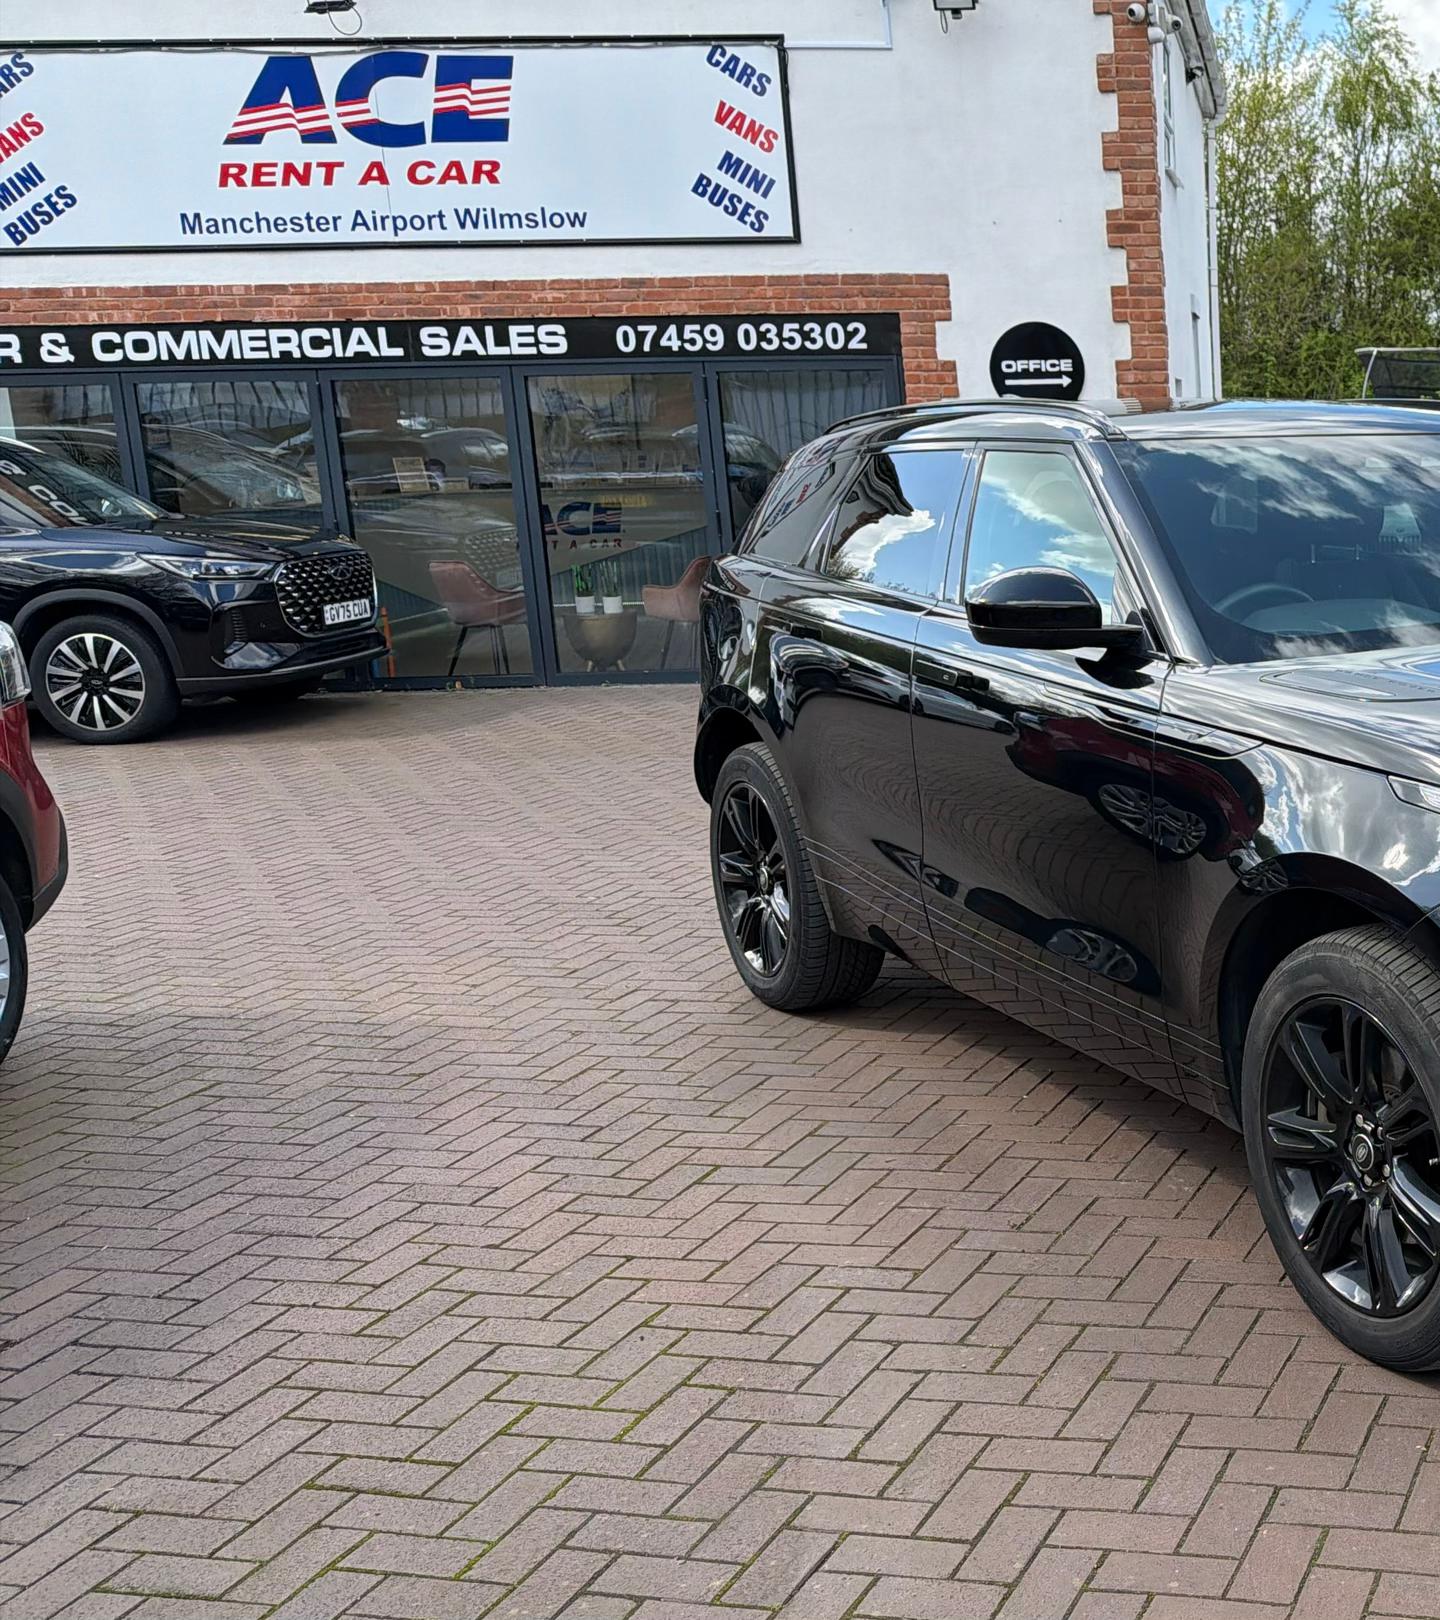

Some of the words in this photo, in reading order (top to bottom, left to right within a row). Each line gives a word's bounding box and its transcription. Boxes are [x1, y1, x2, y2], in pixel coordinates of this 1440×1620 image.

[706, 44, 772, 97] CARS
[222, 50, 513, 148] ACE
[714, 99, 779, 154] VANS
[218, 161, 344, 187] RENT
[358, 161, 390, 186] A
[406, 160, 501, 186] CAR
[717, 150, 776, 199] MINI
[3, 185, 77, 246] BUSES
[179, 211, 342, 235] Manchester
[350, 209, 448, 237] Airport
[453, 206, 588, 230] Wilmslow
[691, 172, 769, 233] BUSES
[39, 332, 75, 364] &
[91, 326, 405, 362] COMMERCIAL
[419, 324, 568, 357] SALES
[615, 324, 725, 353] 07459
[737, 321, 868, 351] 035302
[1001, 359, 1073, 373] OFFICE
